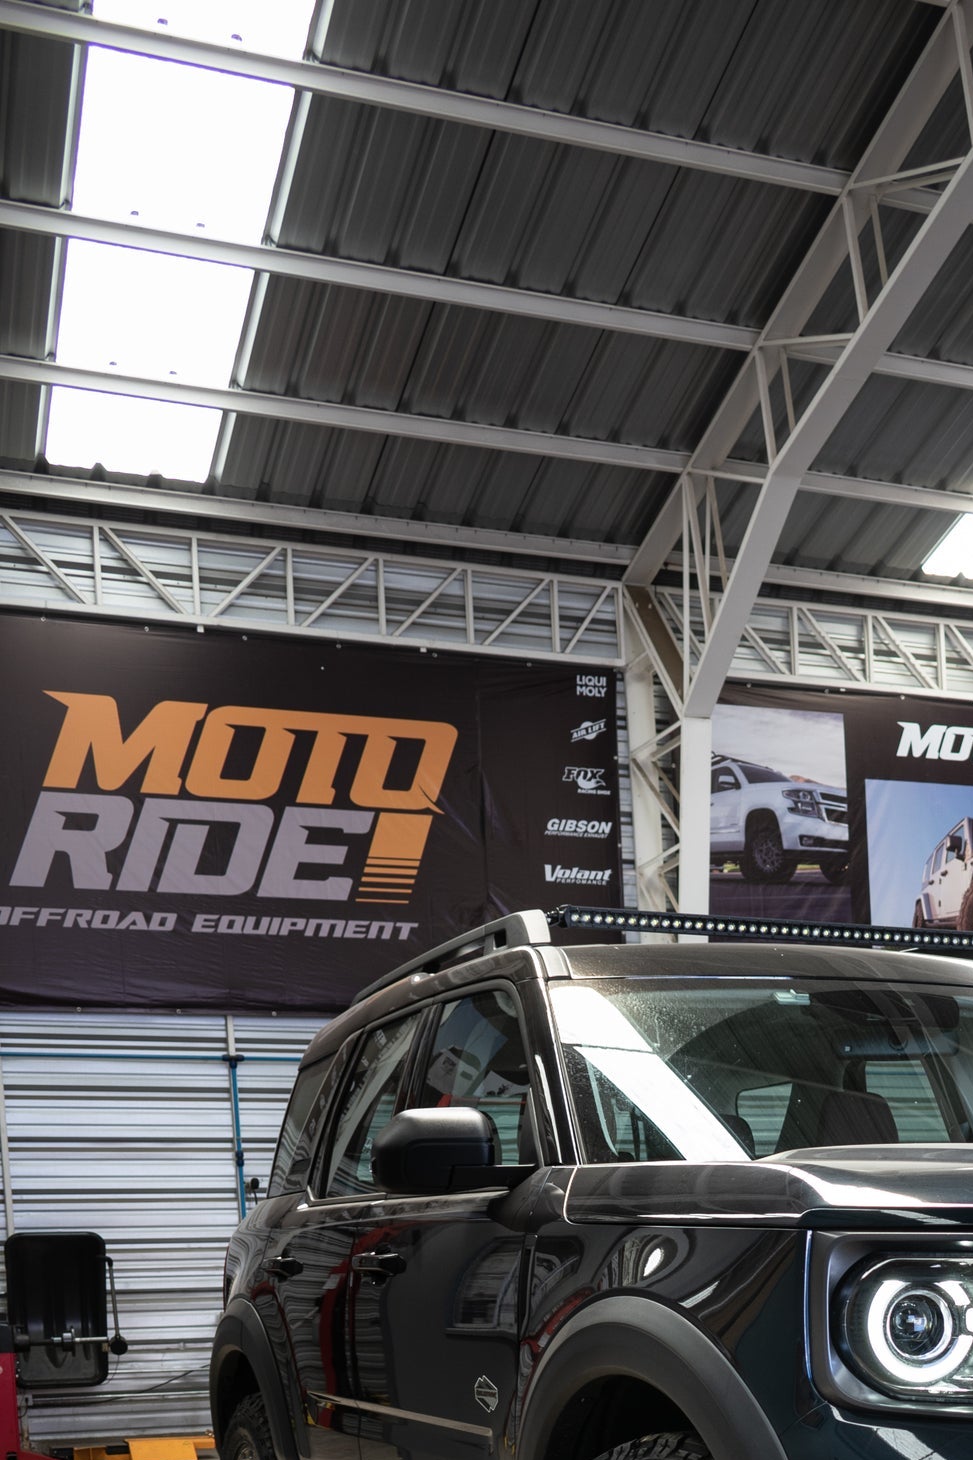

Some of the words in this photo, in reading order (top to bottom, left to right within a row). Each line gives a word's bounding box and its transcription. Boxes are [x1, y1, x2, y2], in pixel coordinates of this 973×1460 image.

[576, 675, 606, 686] LIQUI
[576, 686, 607, 697] MOLY
[572, 728, 587, 739] AIR
[588, 722, 606, 734] LIFT
[41, 690, 458, 814] MOTO
[562, 766, 605, 782] FOX
[546, 818, 613, 834] GIBSON
[544, 864, 613, 882] Volant
[191, 914, 419, 941] EQUIPMENT
